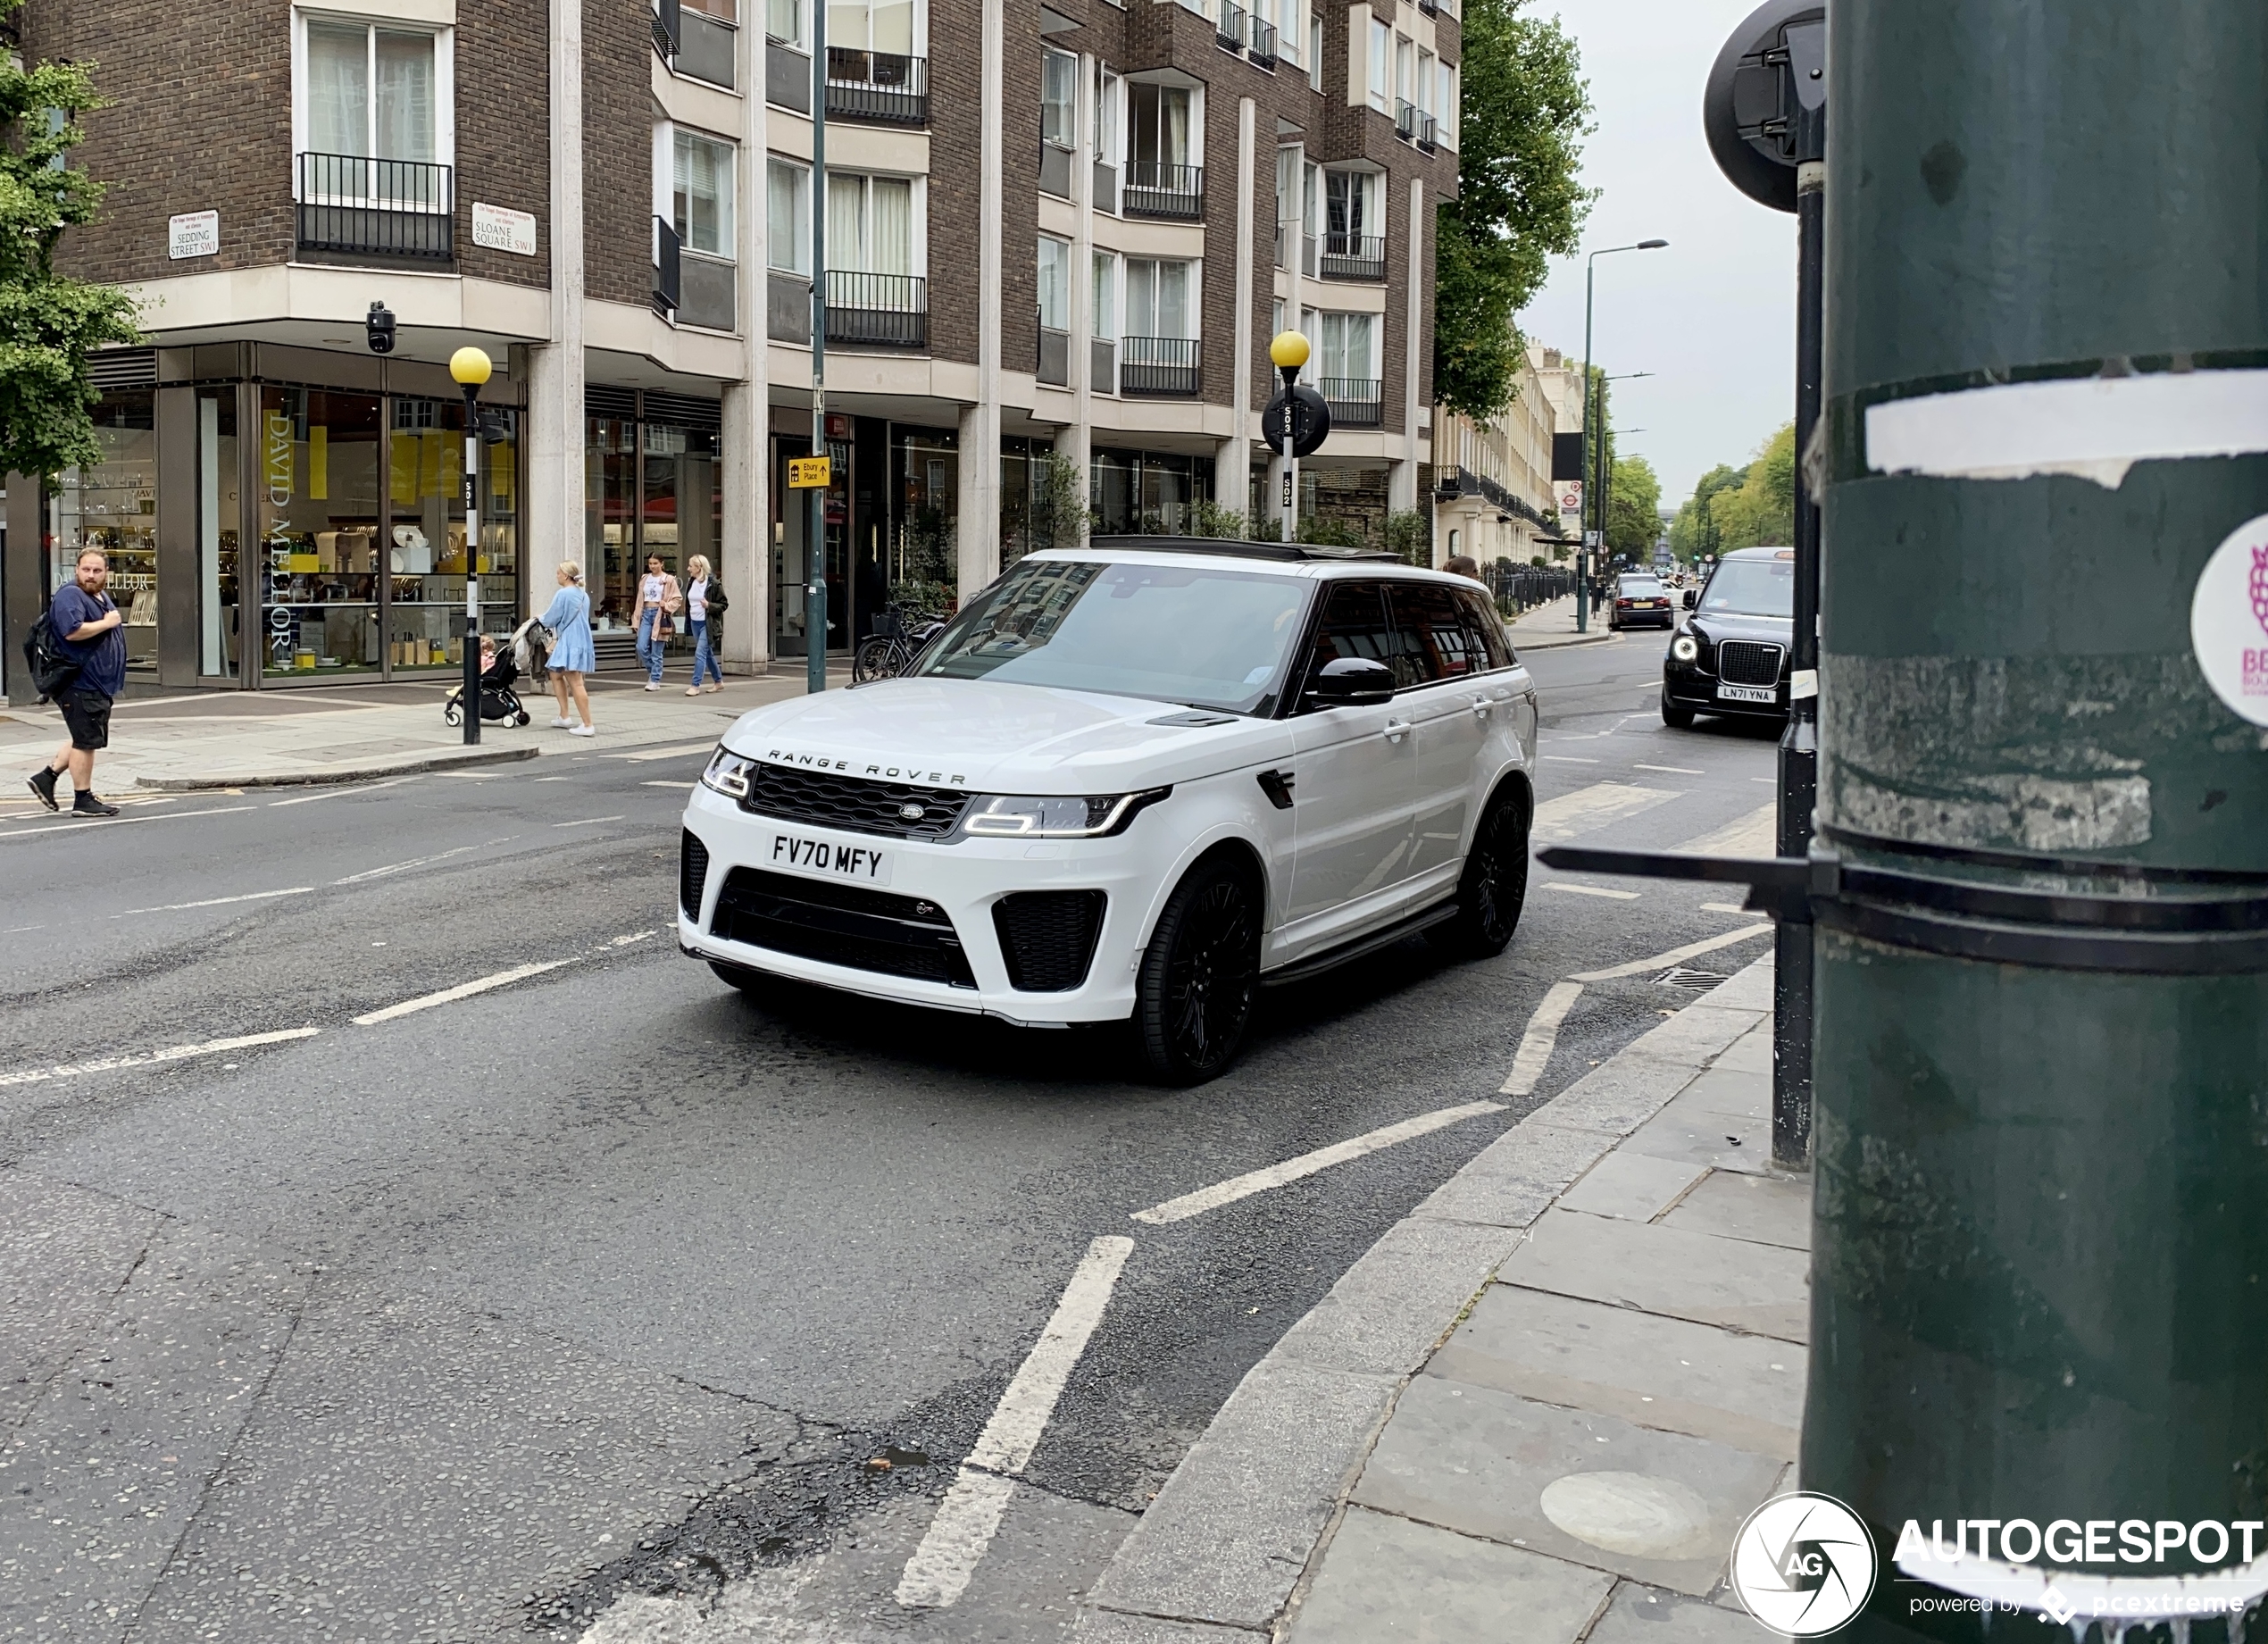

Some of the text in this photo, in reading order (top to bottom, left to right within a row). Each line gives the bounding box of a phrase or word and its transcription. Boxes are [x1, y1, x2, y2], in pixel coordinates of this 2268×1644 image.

[178, 229, 210, 244] SEDDING
[475, 221, 512, 238] SLOANE
[804, 463, 819, 472] Ebury
[804, 472, 818, 480] Place
[270, 413, 291, 650] DAVID MELLOR
[103, 573, 149, 590] ELLOR
[1723, 688, 1770, 701] LN71 YNA
[768, 749, 966, 785] RANGE ROVER
[772, 835, 882, 878] FV70 MFY
